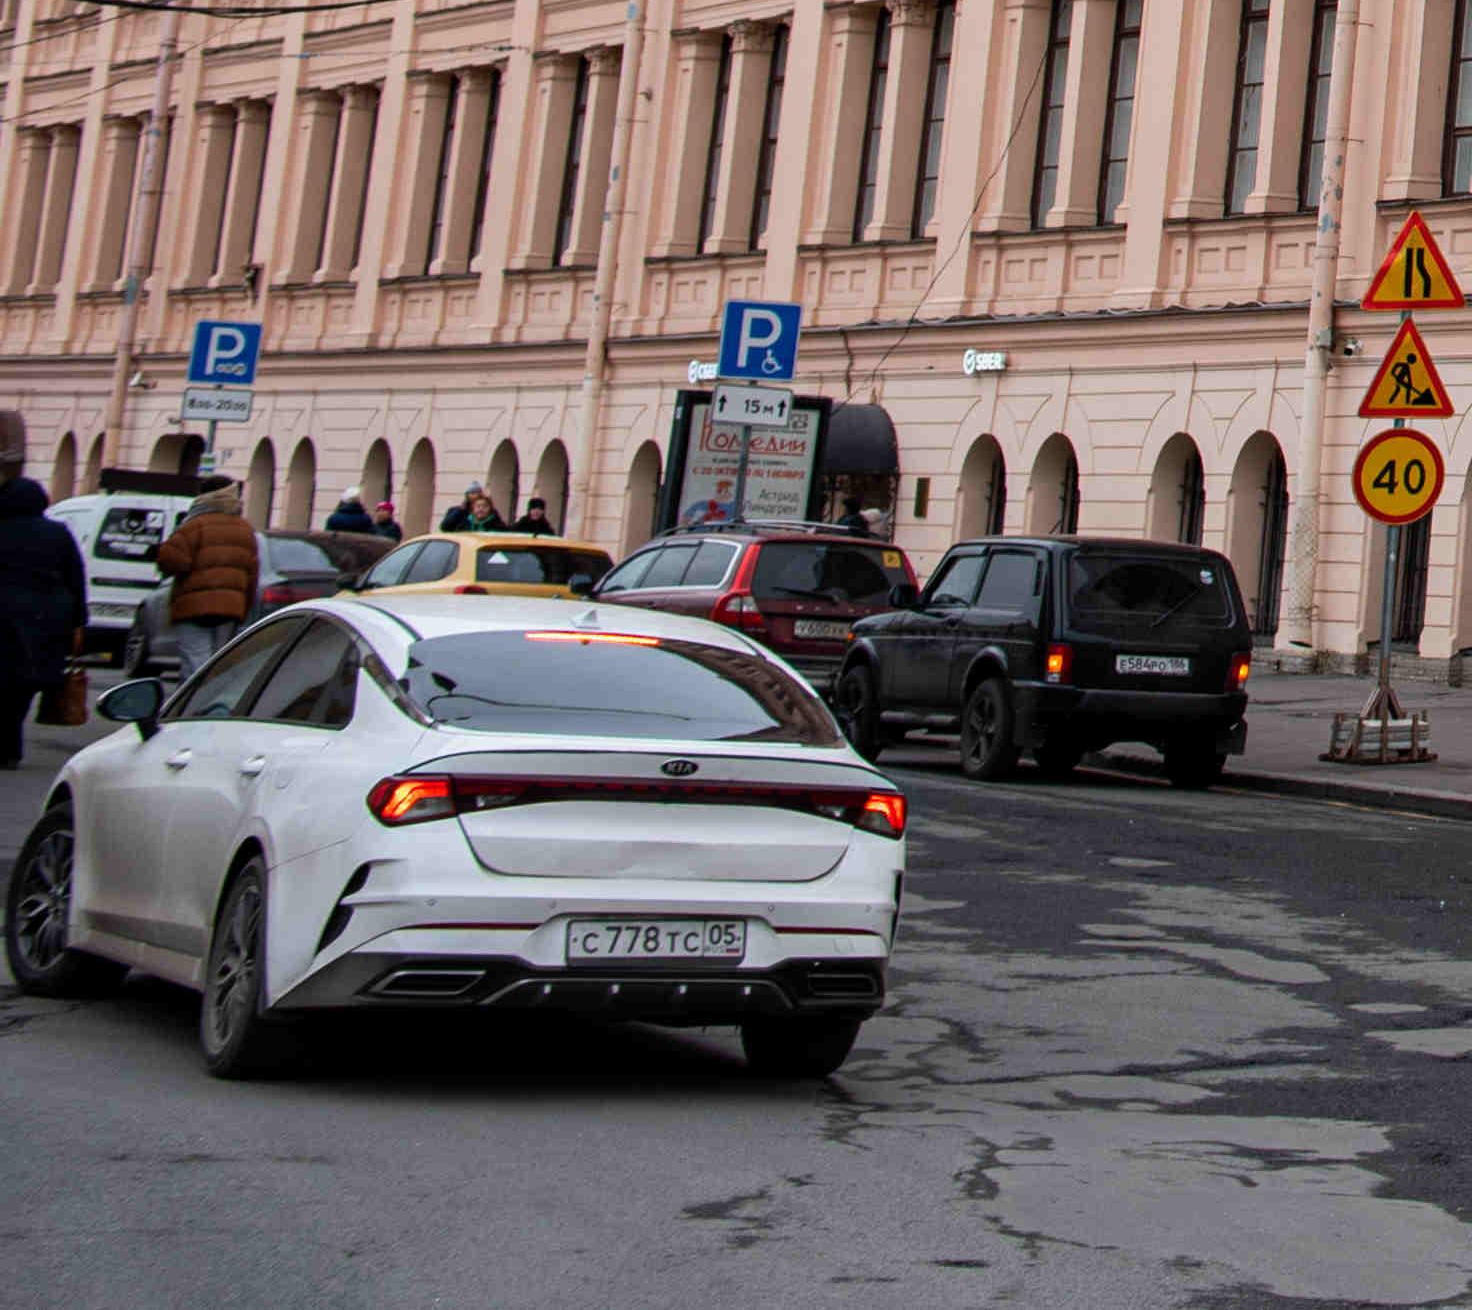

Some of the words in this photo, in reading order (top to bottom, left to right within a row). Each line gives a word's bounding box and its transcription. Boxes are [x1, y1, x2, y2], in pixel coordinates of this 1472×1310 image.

[744, 398, 761, 414] 15
[1372, 458, 1426, 495] 40
[666, 762, 694, 774] KIA
[582, 925, 700, 954] С778ТС
[709, 923, 737, 946] 05
